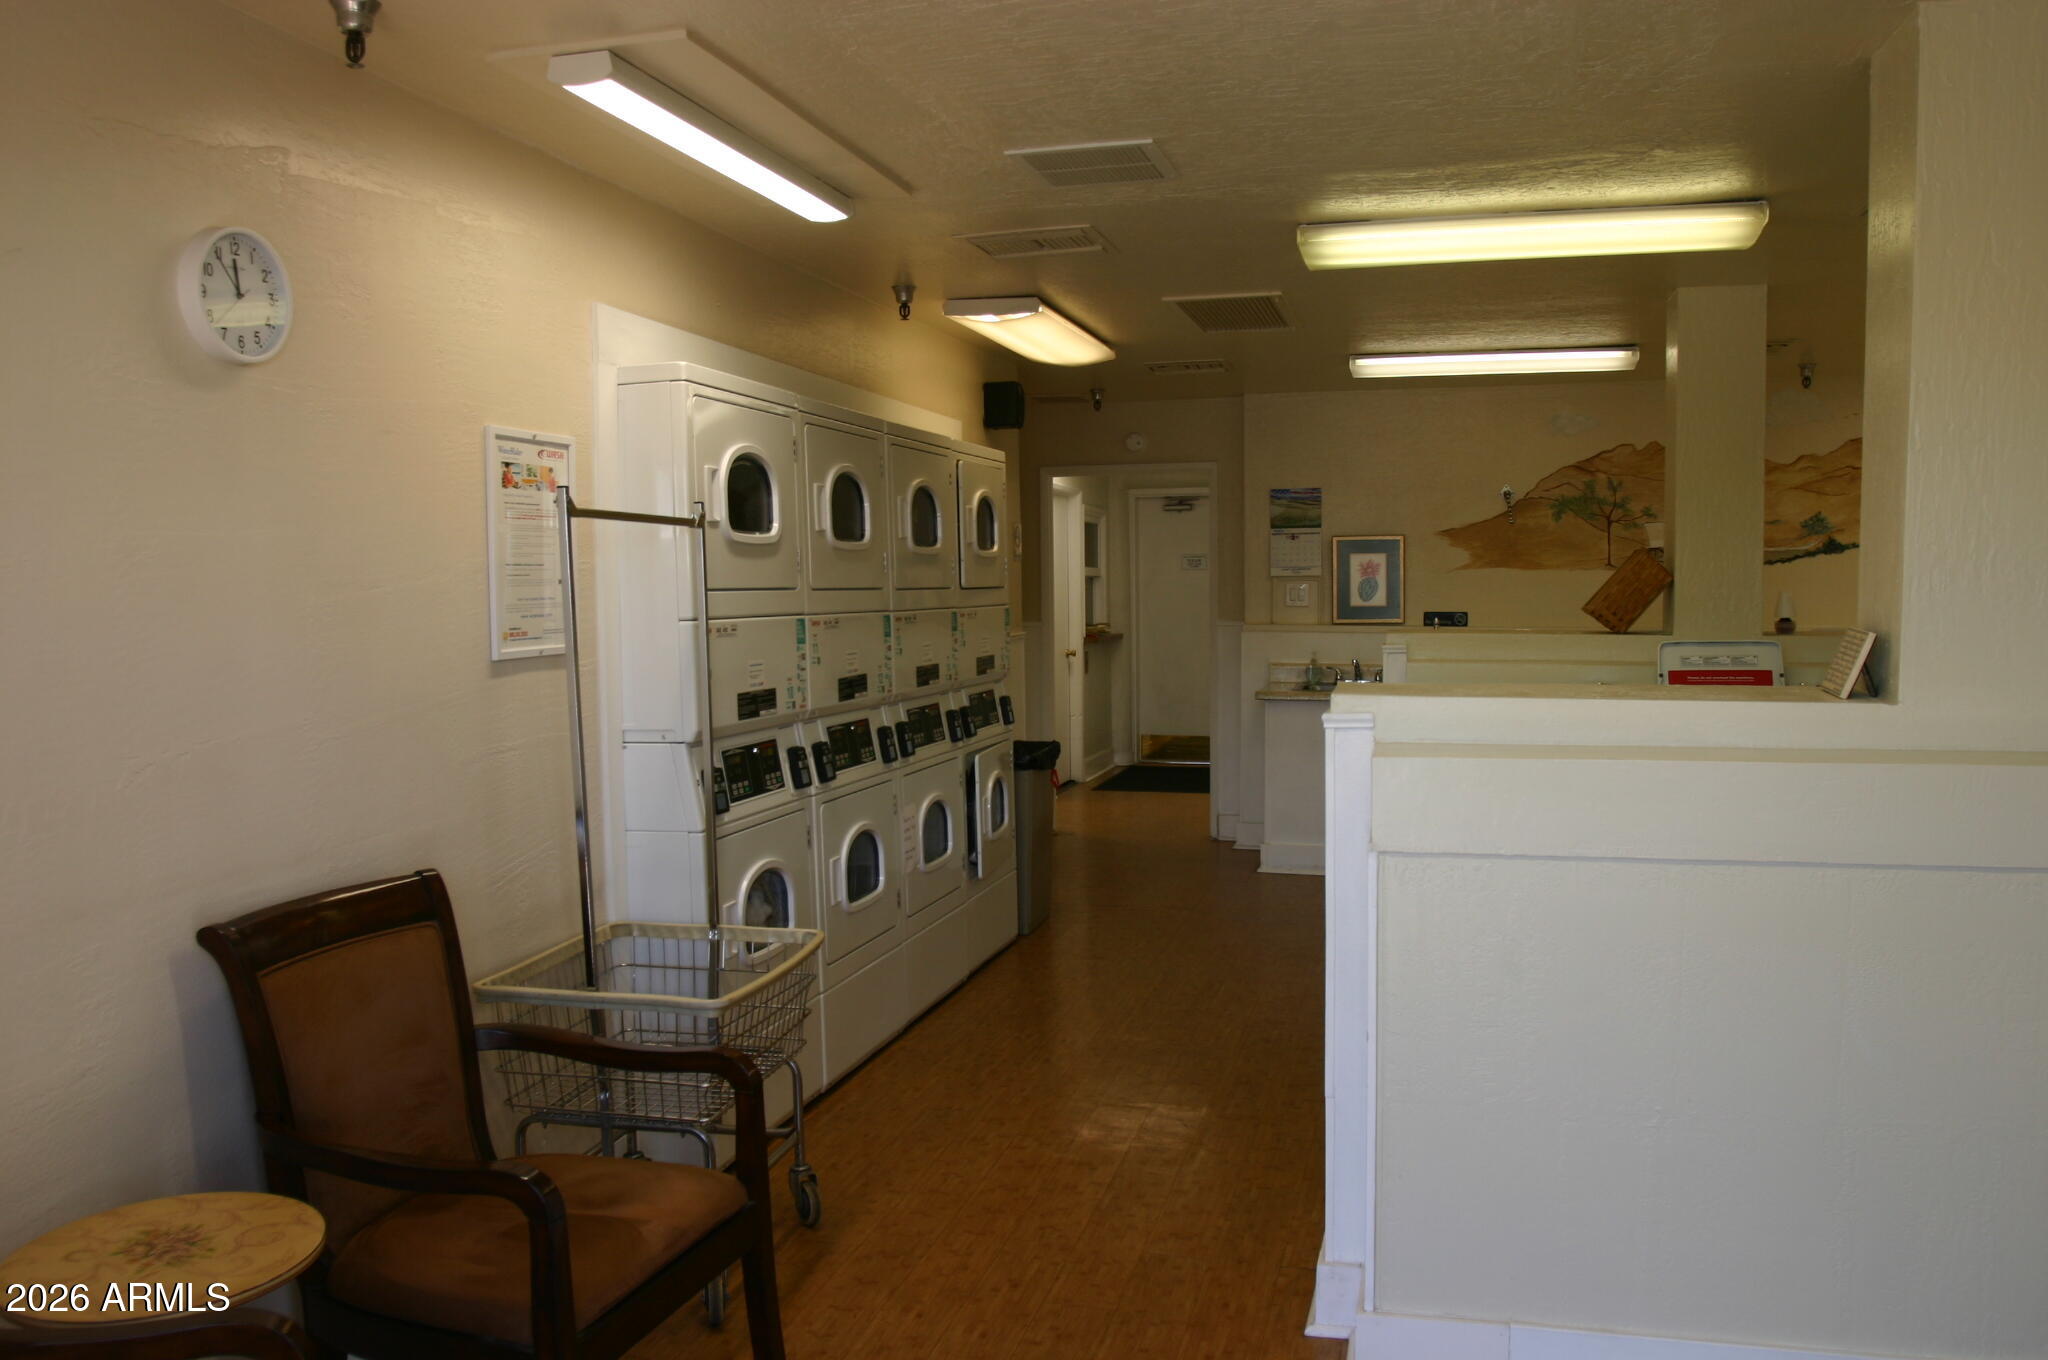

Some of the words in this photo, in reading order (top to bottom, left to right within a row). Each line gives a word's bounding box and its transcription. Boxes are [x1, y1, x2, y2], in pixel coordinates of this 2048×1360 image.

[230, 241, 240, 256] 12
[203, 261, 213, 277] 10
[261, 269, 269, 283] 2
[268, 292, 276, 307] 3
[221, 327, 228, 340] 7
[254, 331, 261, 344] 5
[238, 335, 245, 349] 6
